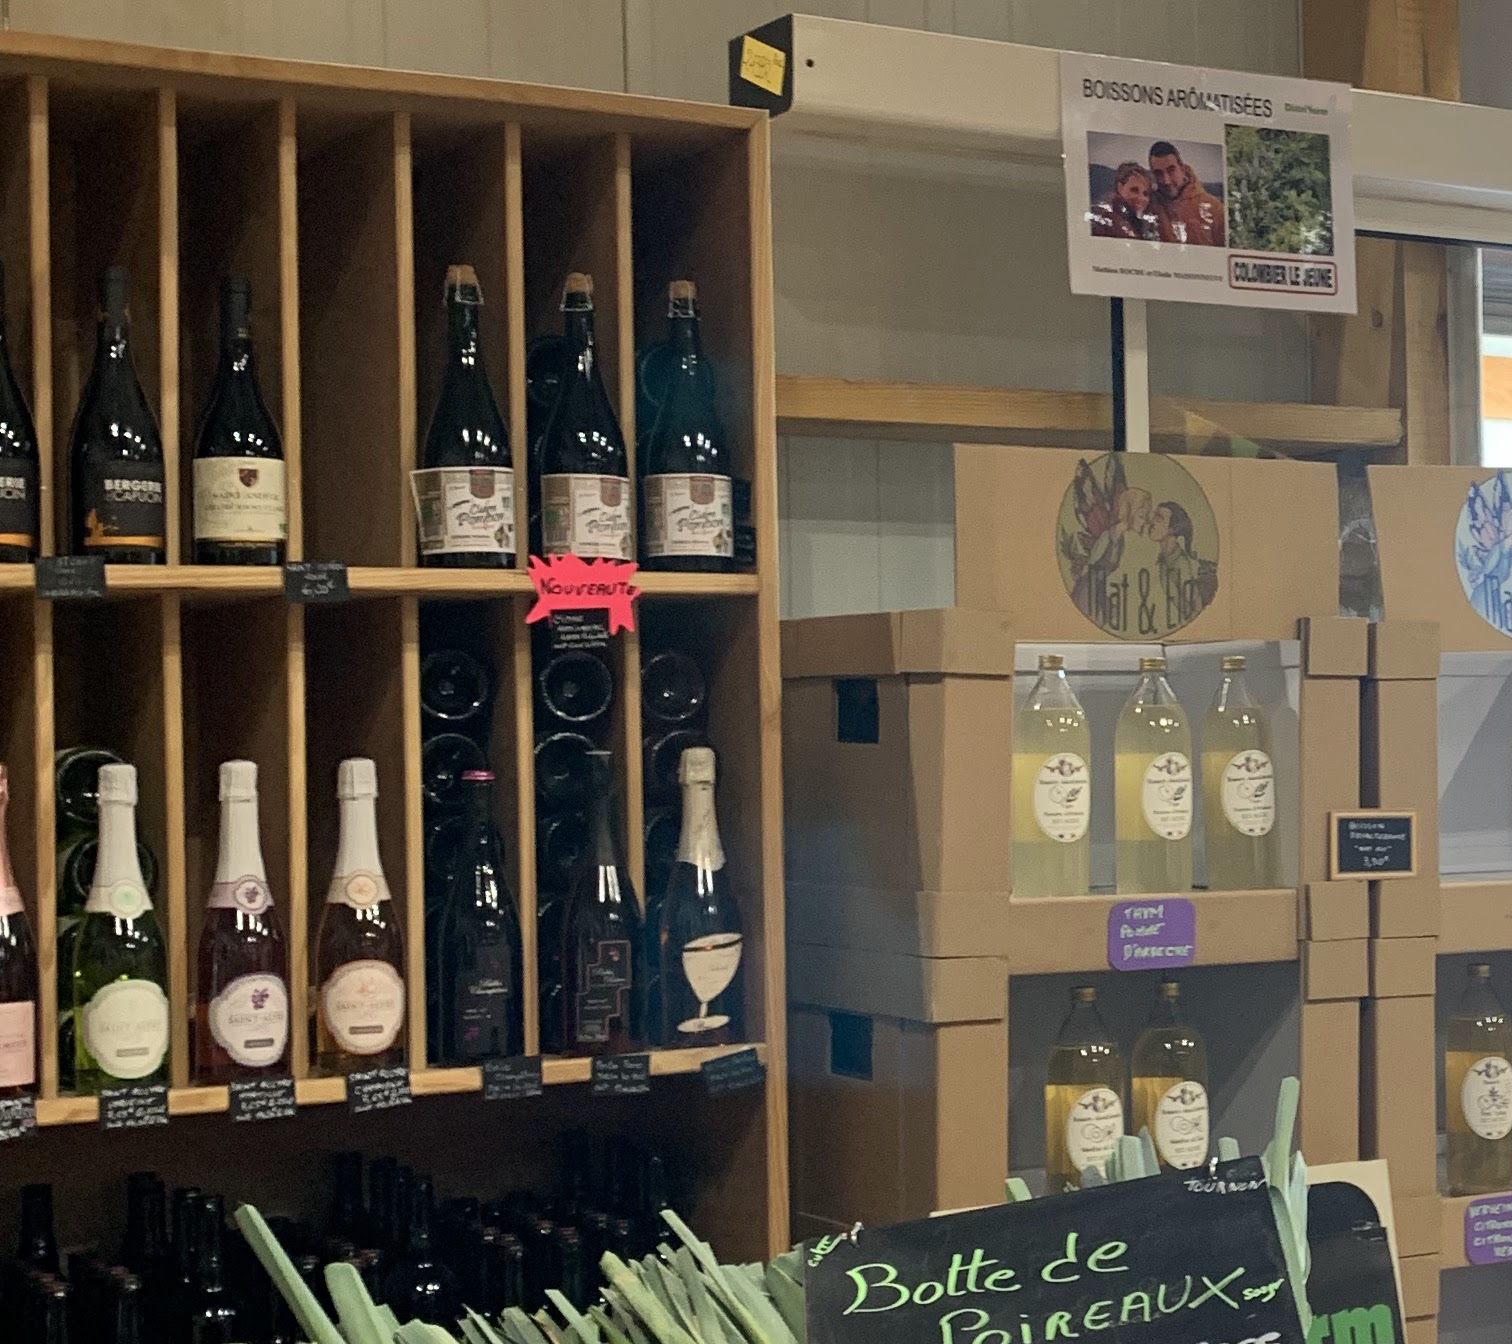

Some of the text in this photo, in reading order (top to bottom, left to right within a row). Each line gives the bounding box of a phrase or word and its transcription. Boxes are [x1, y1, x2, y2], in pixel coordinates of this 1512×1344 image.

[1082, 77, 1165, 108] BOISSONS
[1137, 567, 1158, 636] &
[842, 1232, 1131, 1317] Botte de
